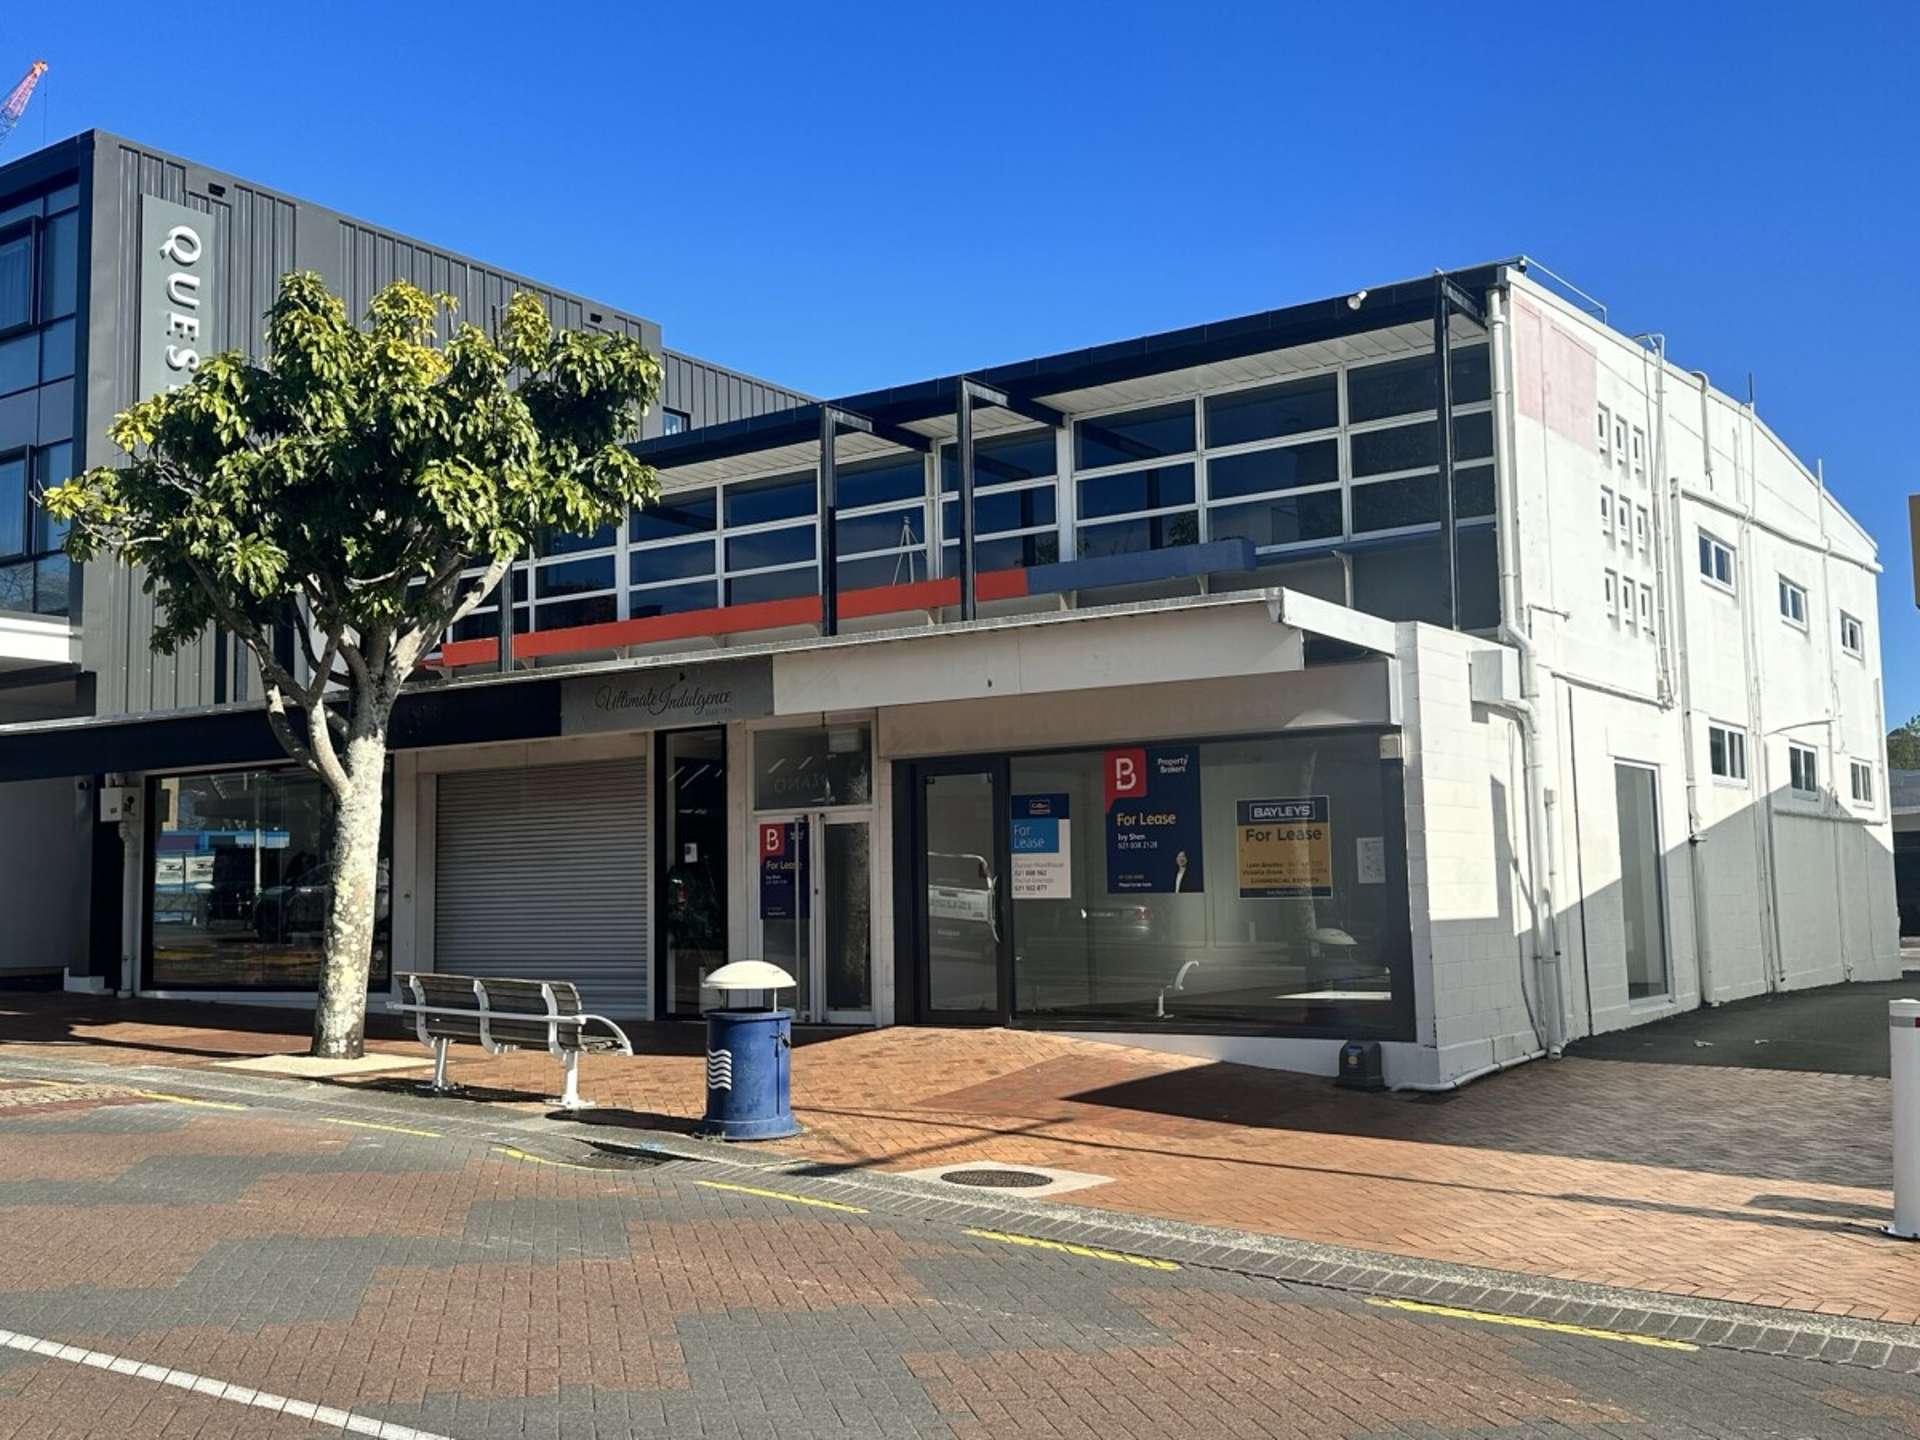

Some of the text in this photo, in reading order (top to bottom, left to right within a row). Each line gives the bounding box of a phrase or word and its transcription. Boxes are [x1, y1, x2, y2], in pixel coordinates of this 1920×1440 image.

[160, 225, 202, 392] QUES
[648, 683, 732, 715] Indulgence
[1157, 756, 1189, 767] Property
[1116, 758, 1136, 790] B
[1253, 805, 1311, 818] BAYLEYS
[1116, 812, 1176, 826] For Lease
[1013, 824, 1032, 836] For
[1245, 828, 1322, 843] For Lease
[766, 828, 779, 850] B
[1013, 837, 1046, 849] Lease
[766, 860, 802, 871] For Lea
